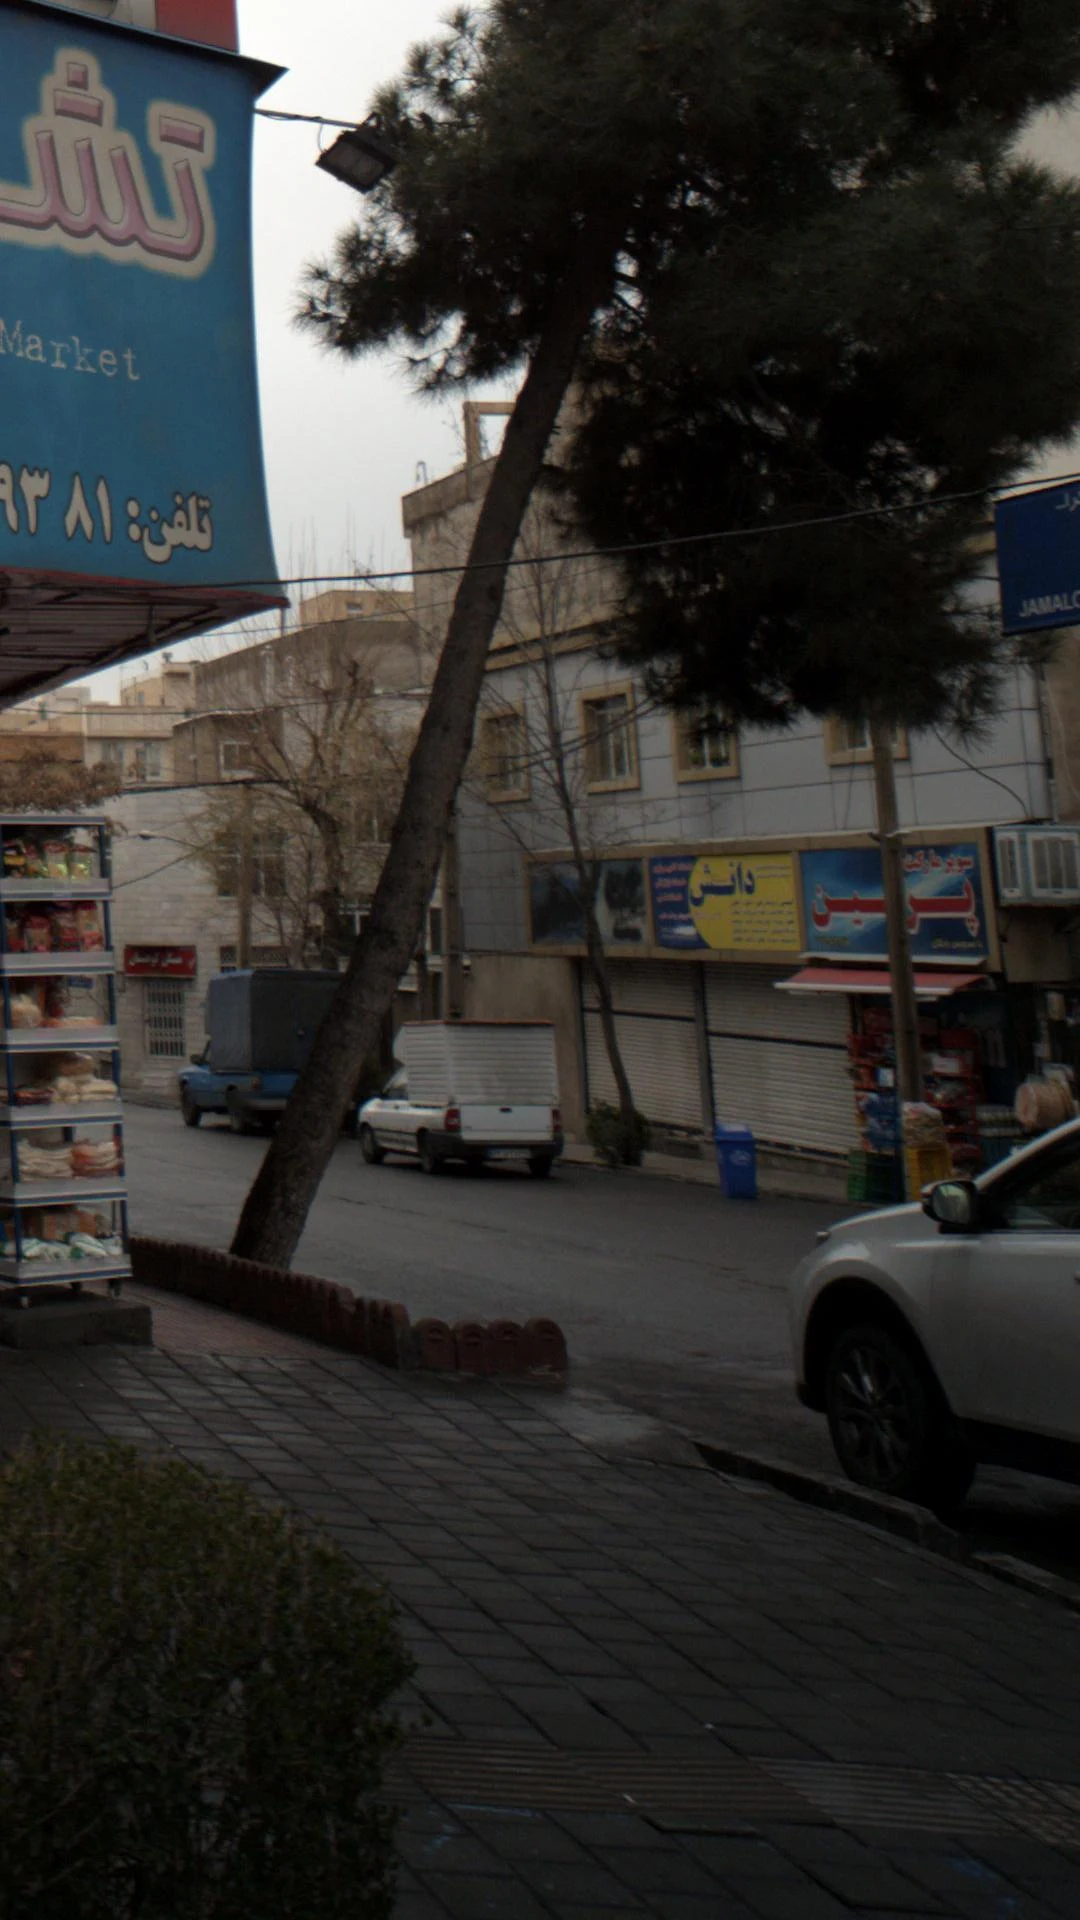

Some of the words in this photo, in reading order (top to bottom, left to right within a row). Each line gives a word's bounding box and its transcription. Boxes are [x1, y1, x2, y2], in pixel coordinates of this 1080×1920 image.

[0, 316, 141, 381] Market
[126, 490, 214, 565] تلفن:
[691, 861, 756, 907] دانش
